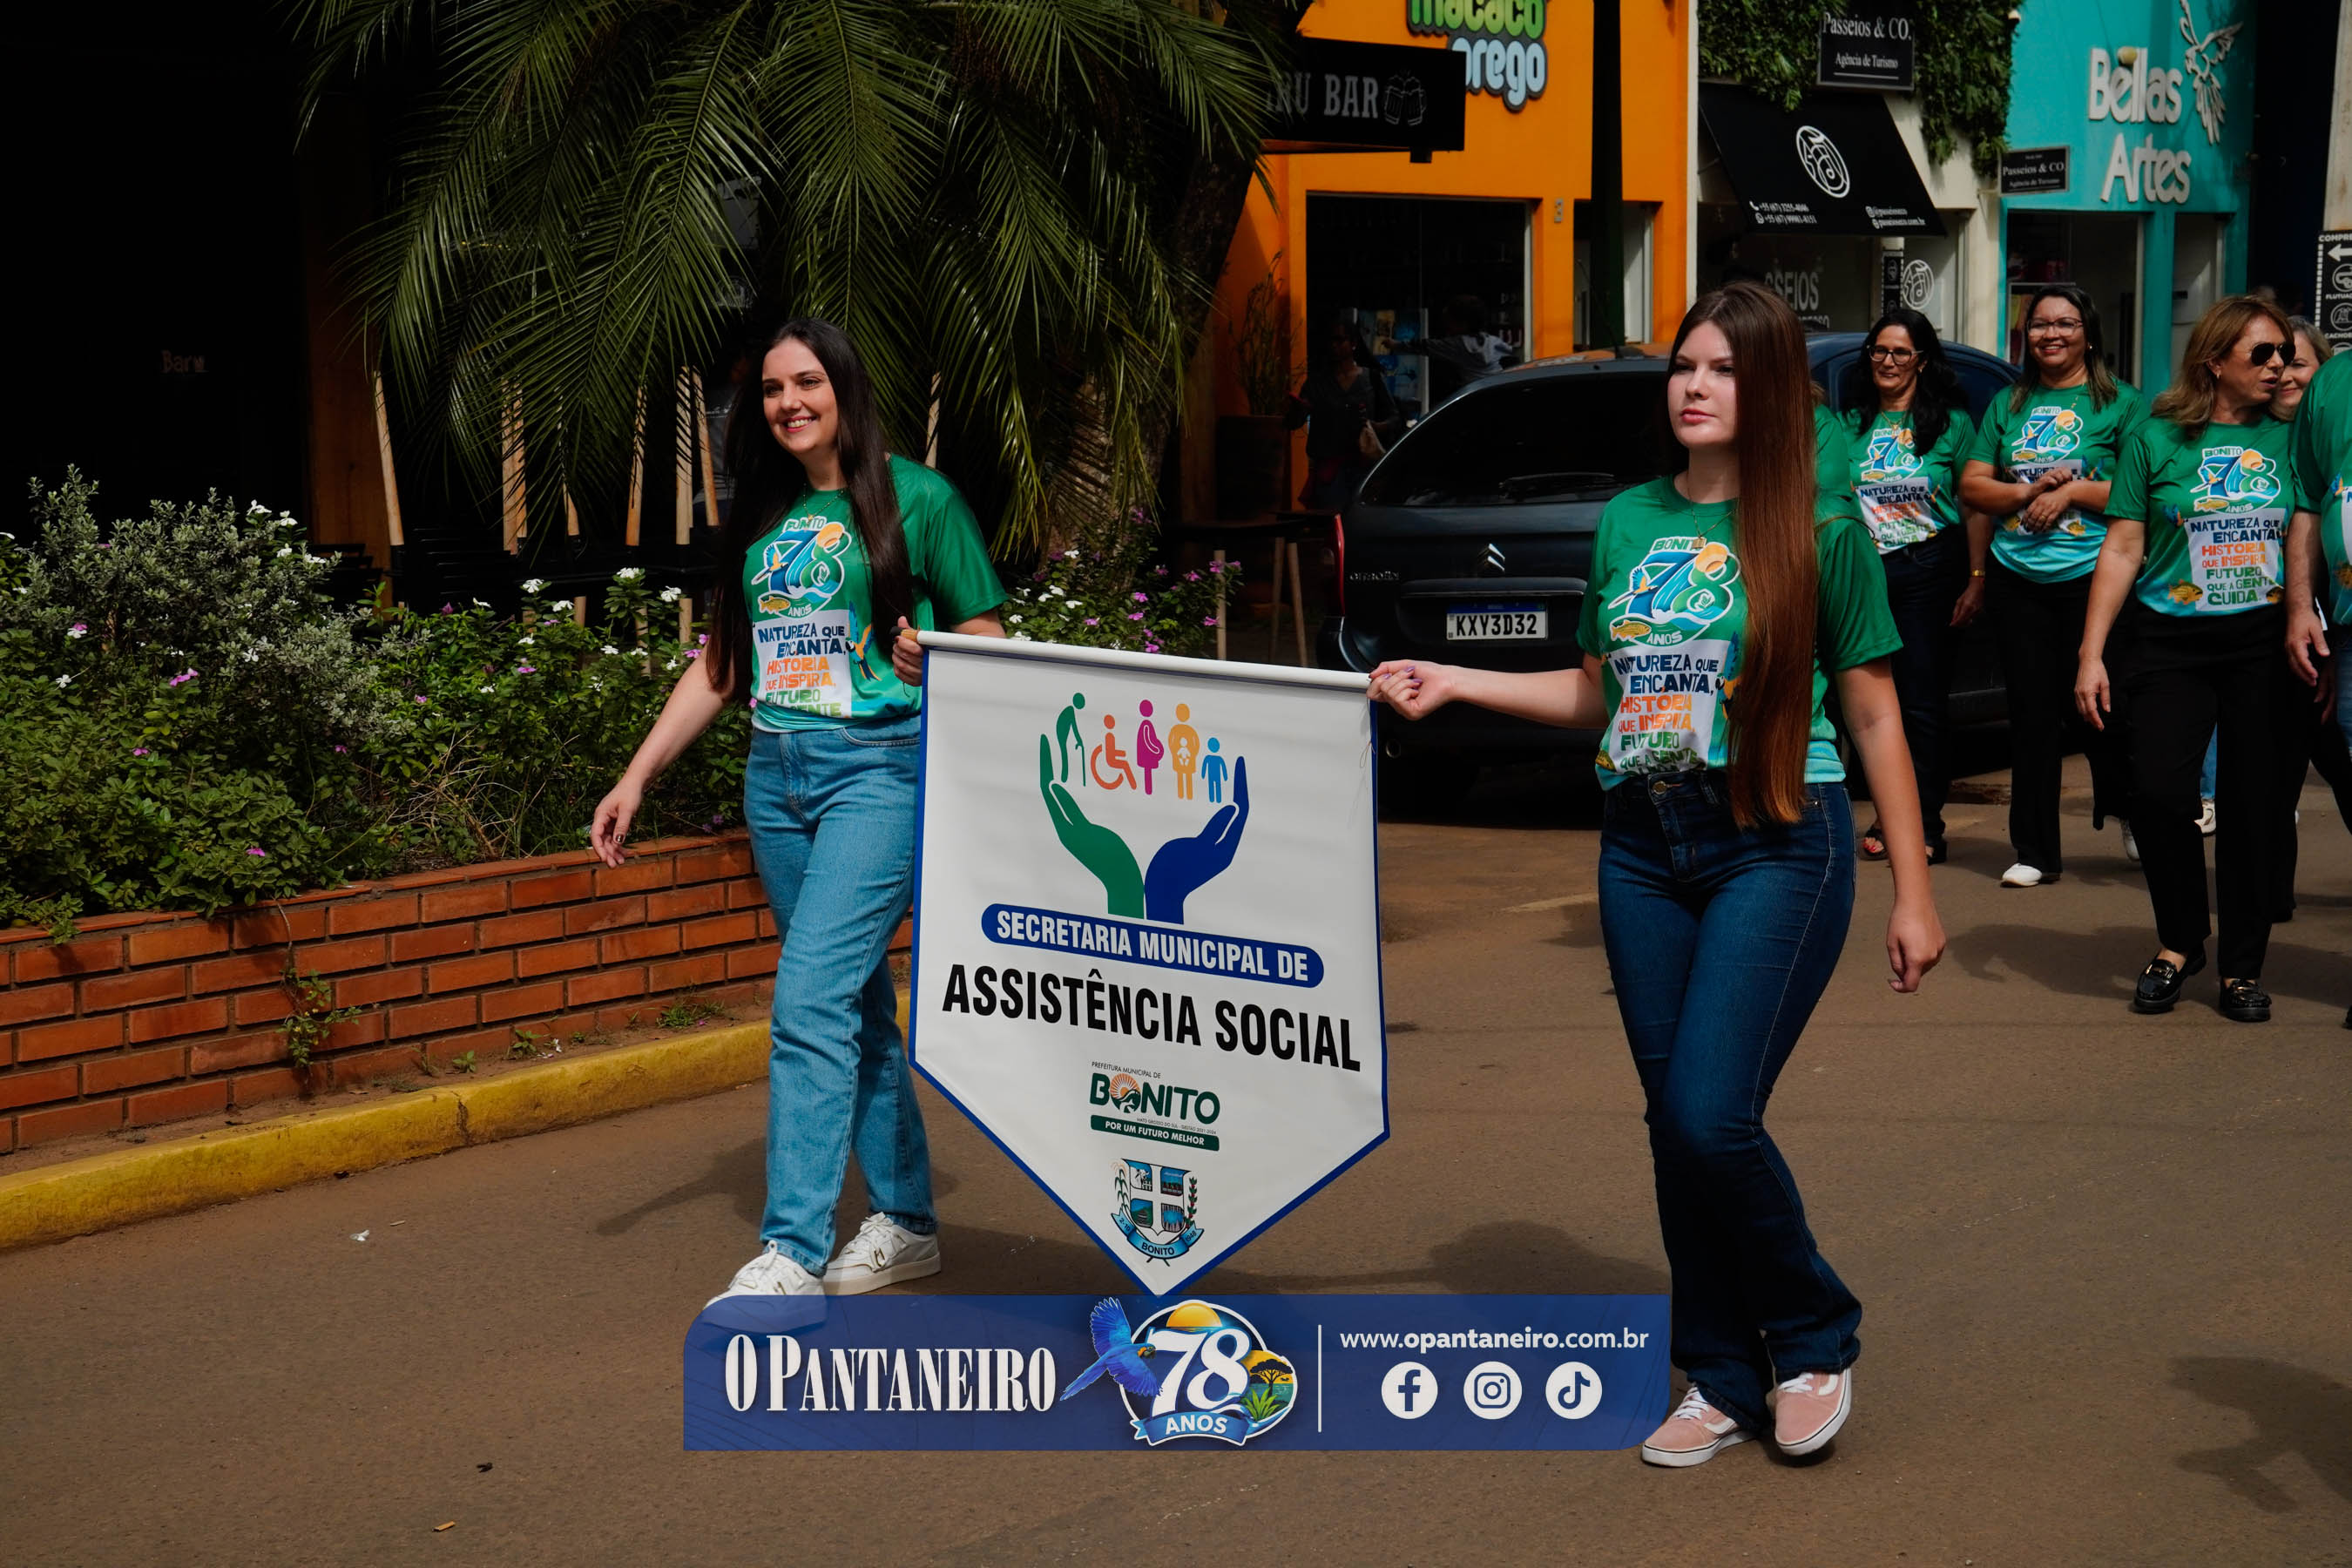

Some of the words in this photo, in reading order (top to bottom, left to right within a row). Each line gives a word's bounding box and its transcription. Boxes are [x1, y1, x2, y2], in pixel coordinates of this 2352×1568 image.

[1822, 11, 1871, 37] Passeios
[1874, 16, 1885, 38] &
[1862, 53, 1871, 67] de
[1871, 54, 1899, 70] Turismo
[2088, 46, 2184, 125] Bellas
[1323, 72, 1380, 119] BAR
[2038, 162, 2048, 174] &
[2100, 132, 2193, 205] Artes
[2204, 448, 2242, 457] BONITO
[1860, 485, 1908, 497] NATUREZA
[2225, 503, 2254, 513] ANOS
[2190, 517, 2260, 532] NATUREZA
[1652, 537, 1704, 551] BONIT
[770, 522, 852, 596] 78
[2202, 559, 2219, 568] QUE
[2206, 566, 2263, 579] FUTURO
[1627, 542, 1740, 625] 78
[2207, 582, 2227, 591] QUE
[787, 604, 812, 617] ANOS
[758, 622, 817, 643] NATUREZA
[821, 625, 845, 639] QUE
[1456, 613, 1537, 637] KXY3D32
[1646, 631, 1683, 645] ANOS
[767, 656, 830, 676] HISTORIA
[1614, 654, 1692, 675] NATUREZA
[1695, 659, 1719, 673] QUE
[765, 679, 777, 691] QUE
[1630, 673, 1714, 695] ENCANTA,
[766, 689, 821, 704] FUTURO
[1618, 720, 1636, 733] QUE
[1620, 755, 1642, 770] QUE
[997, 910, 1132, 956] SECRETARIA
[1139, 931, 1269, 977] MUNICIPAL
[1277, 950, 1308, 982] DE
[943, 963, 1201, 1047] ASSISTÊNCIA
[1215, 1000, 1361, 1072] SOCIAL
[1092, 1061, 1121, 1072] PREFEITURA
[1122, 1067, 1152, 1078] MUNICIPAL
[1089, 1072, 1220, 1125] BONITO
[1105, 1120, 1122, 1131] POR
[1123, 1124, 1136, 1133] UM
[1138, 1127, 1170, 1139] FUTURO
[1171, 1132, 1205, 1146] MELHOR
[1185, 1230, 1197, 1242] 1948
[1141, 1241, 1174, 1255] BONITO
